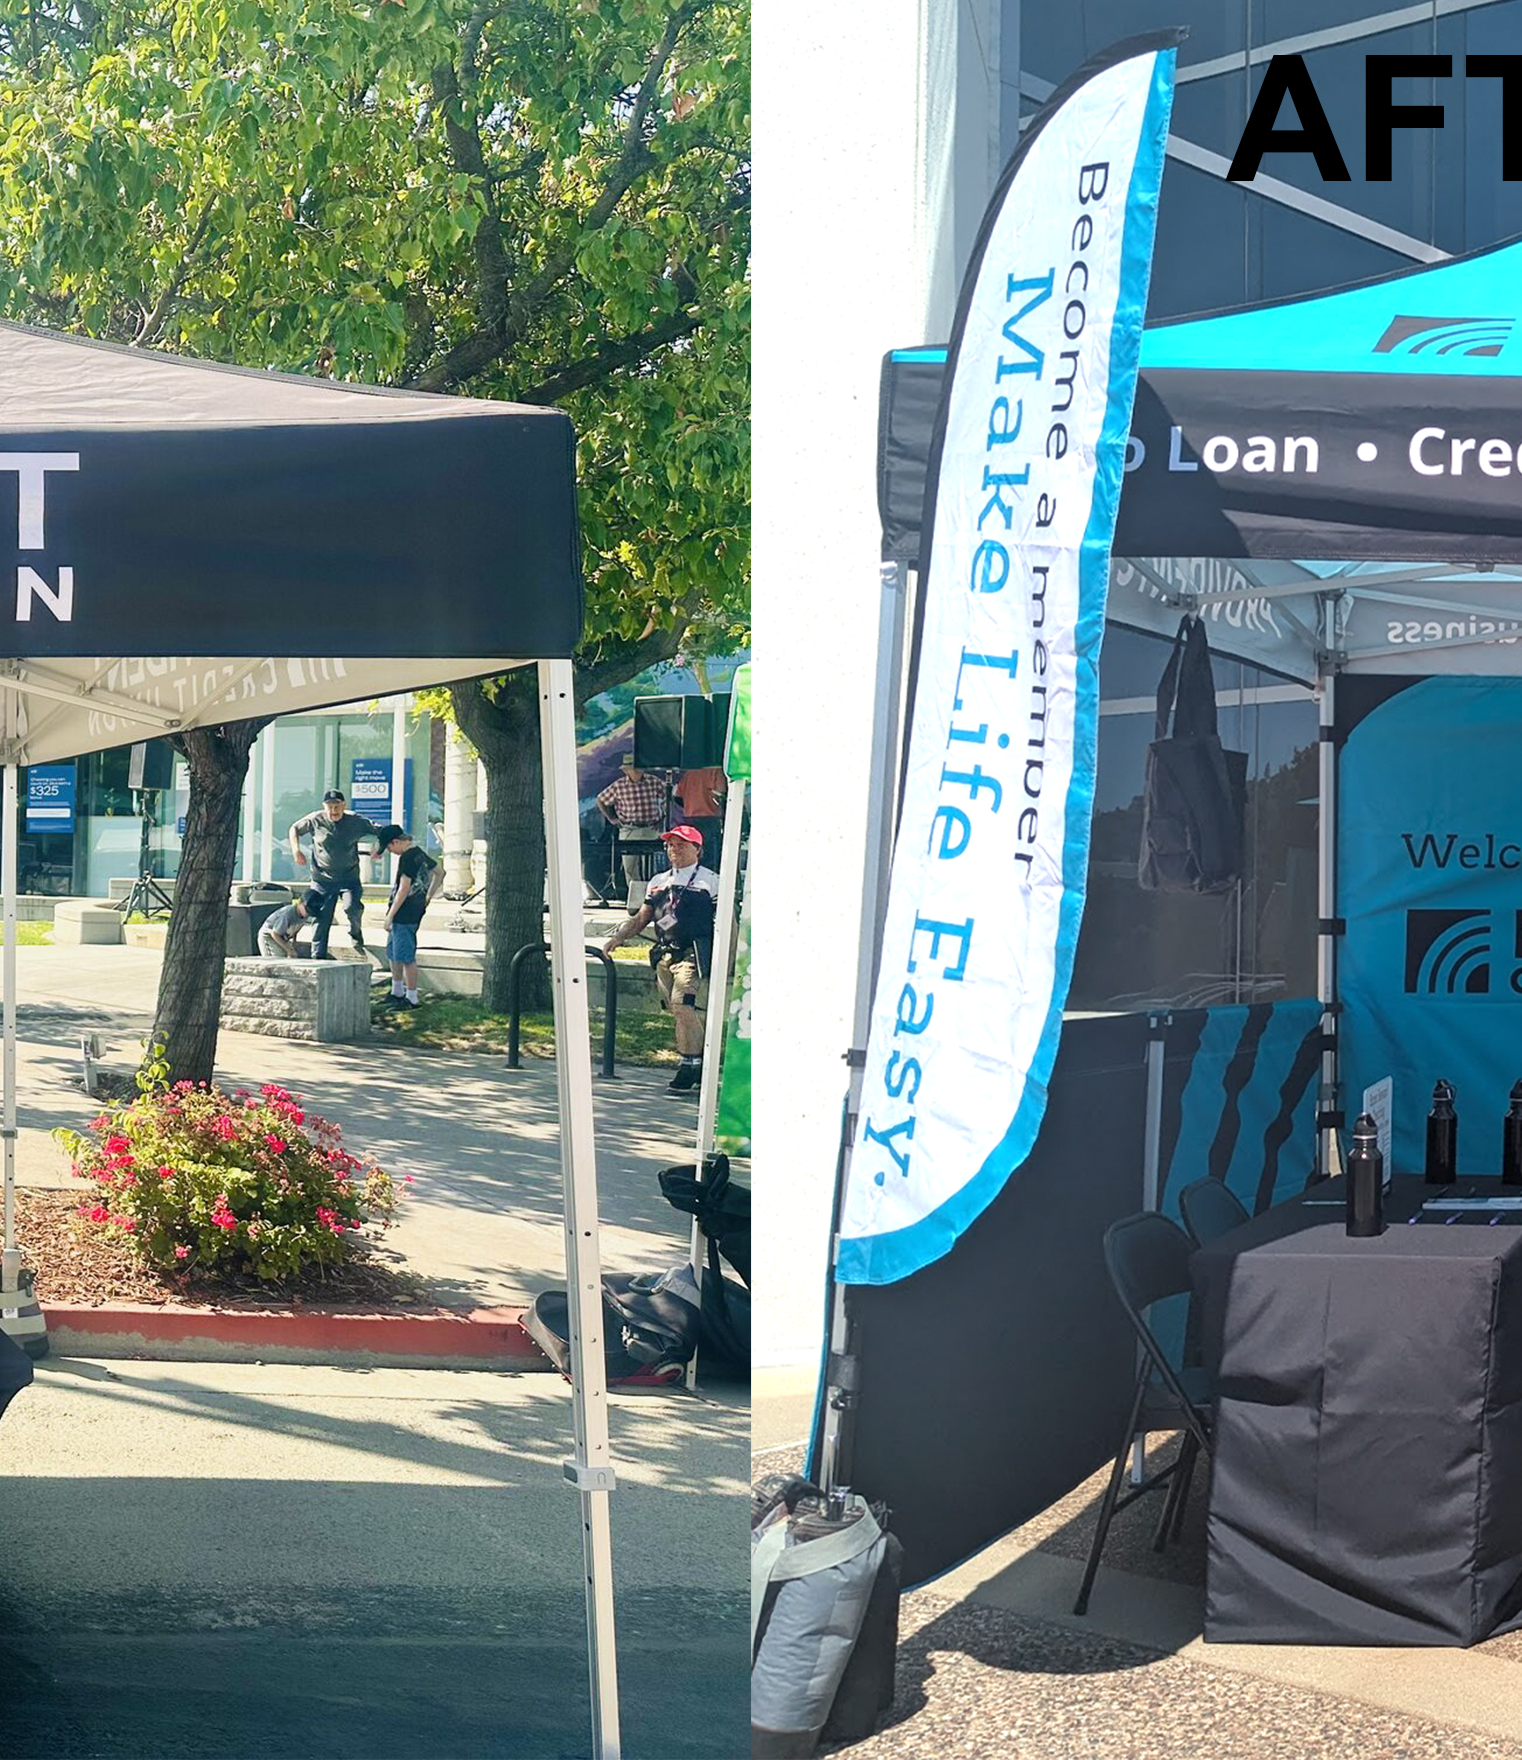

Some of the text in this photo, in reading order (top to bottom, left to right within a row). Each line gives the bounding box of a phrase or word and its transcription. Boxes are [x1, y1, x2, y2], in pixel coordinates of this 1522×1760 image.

[1167, 426, 1319, 474] Loan
[1013, 162, 1110, 880] Become a member
[864, 267, 1056, 1187] Make Life Easy.
[30, 785, 60, 797] $325
[355, 784, 387, 794] $500
